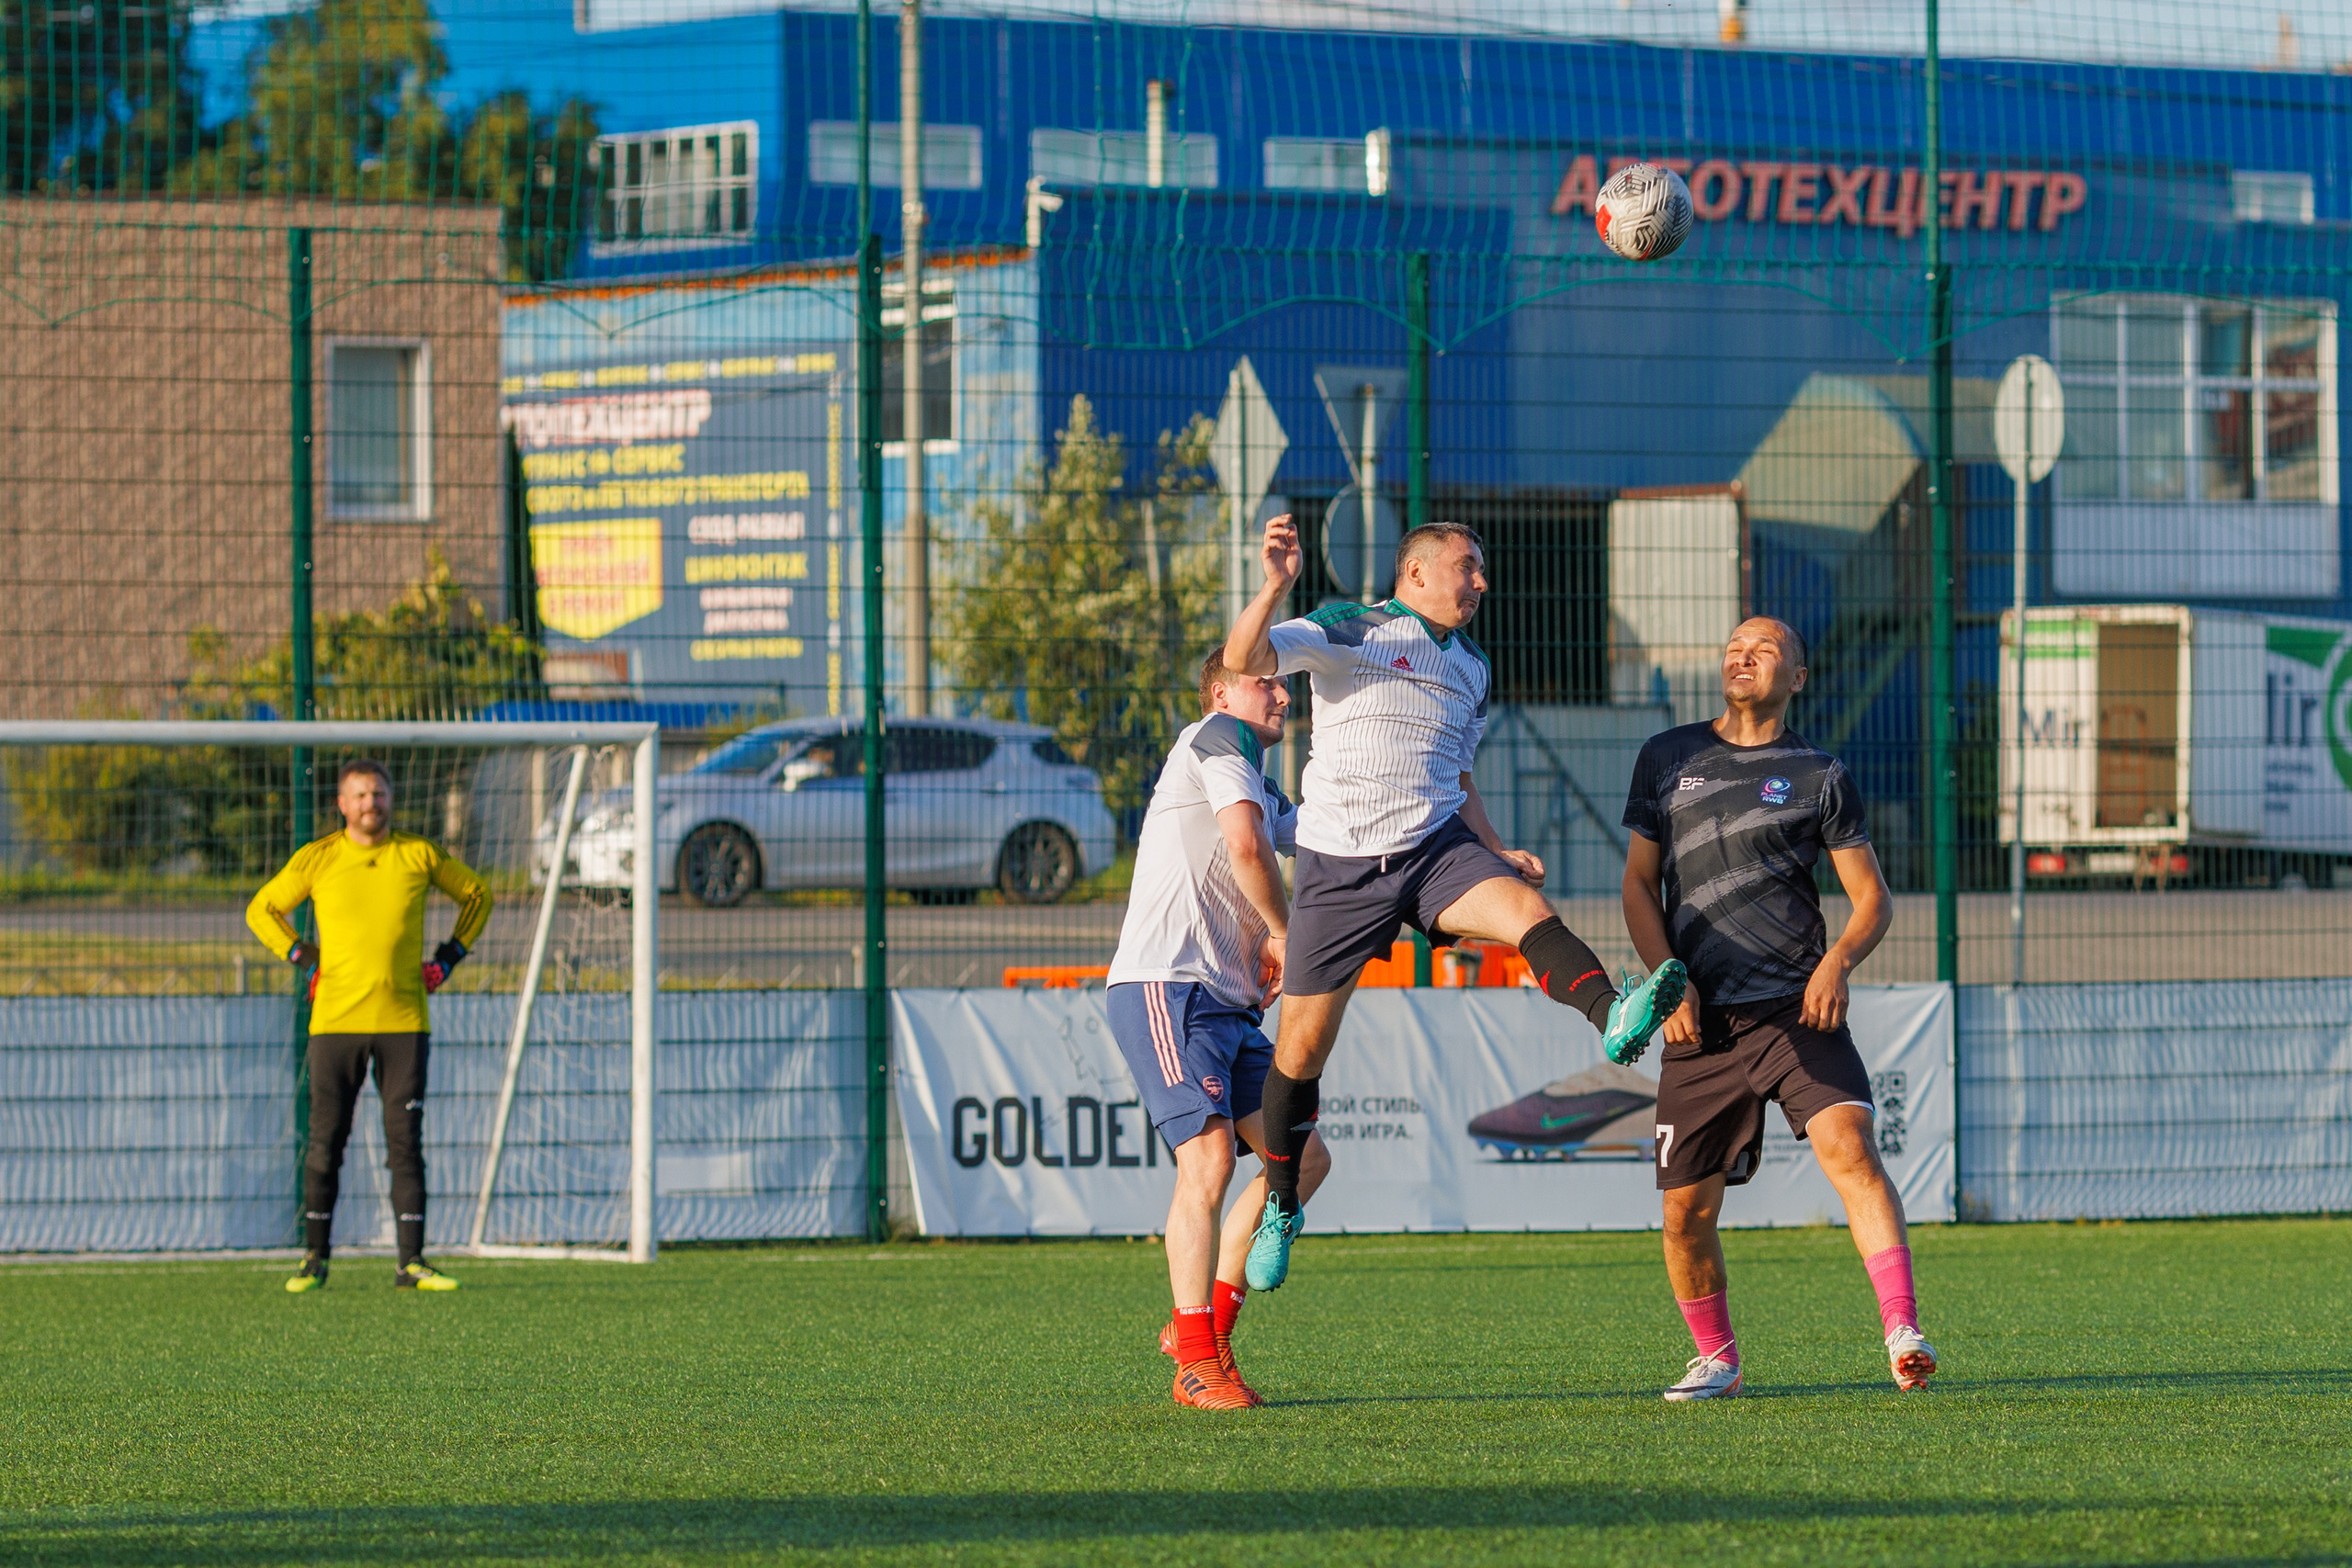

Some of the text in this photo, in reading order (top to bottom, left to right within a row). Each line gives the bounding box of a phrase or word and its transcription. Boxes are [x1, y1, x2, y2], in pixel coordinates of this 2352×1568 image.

[1550, 154, 2088, 237] АОТЕХЦЕНТР
[1679, 776, 1705, 791] BF
[1760, 791, 1788, 800] PLANET
[1318, 1094, 1357, 1114] ВОЙ
[1317, 1123, 1354, 1140] ВОЯ
